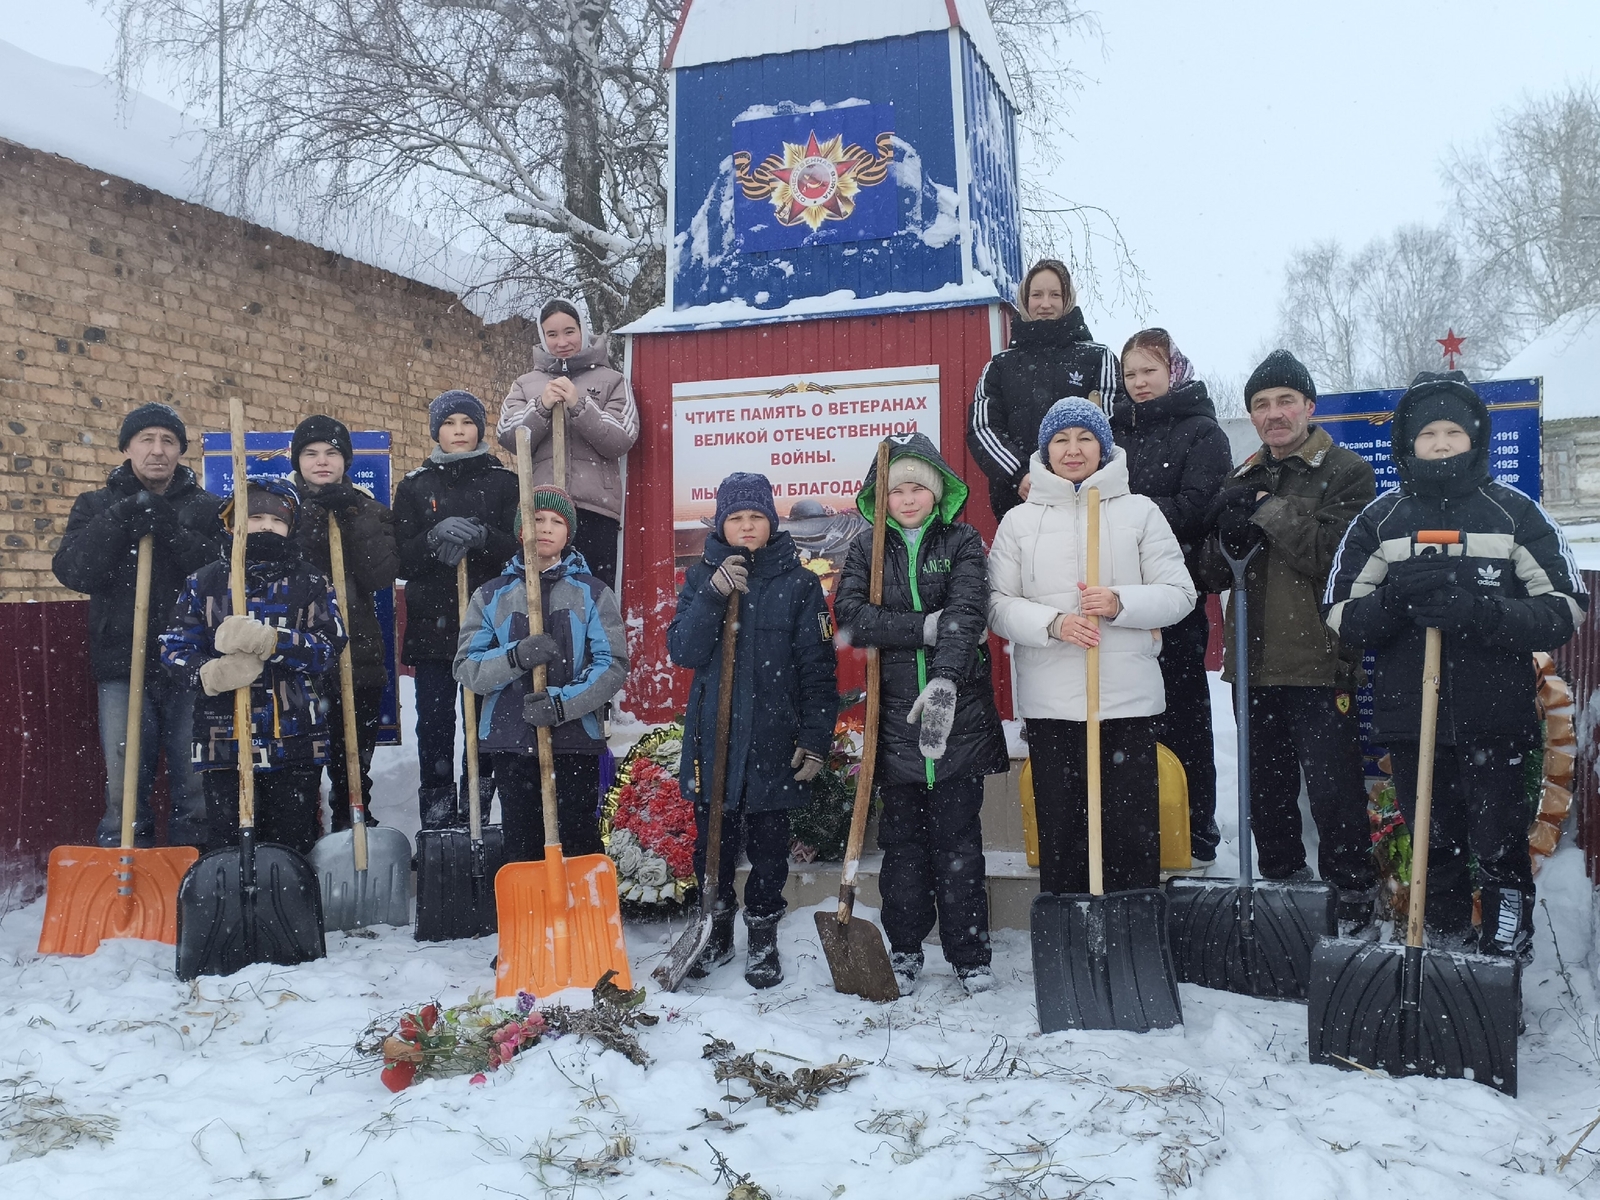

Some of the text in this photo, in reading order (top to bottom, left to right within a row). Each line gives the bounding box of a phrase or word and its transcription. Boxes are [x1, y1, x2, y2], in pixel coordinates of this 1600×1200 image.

[685, 396, 928, 425] ЧТИТЕ ПАМЯТЬ О ВЕТЕРАНАХ
[694, 418, 919, 447] ВЕЛИКОЙ ОТЕЧЕСТВЕННОЙ
[1493, 431, 1519, 441] -1916
[1375, 439, 1392, 448] Вас
[1493, 445, 1519, 455] -1903
[770, 448, 837, 466] ВОЙНЫ.
[1493, 460, 1519, 469] -1925
